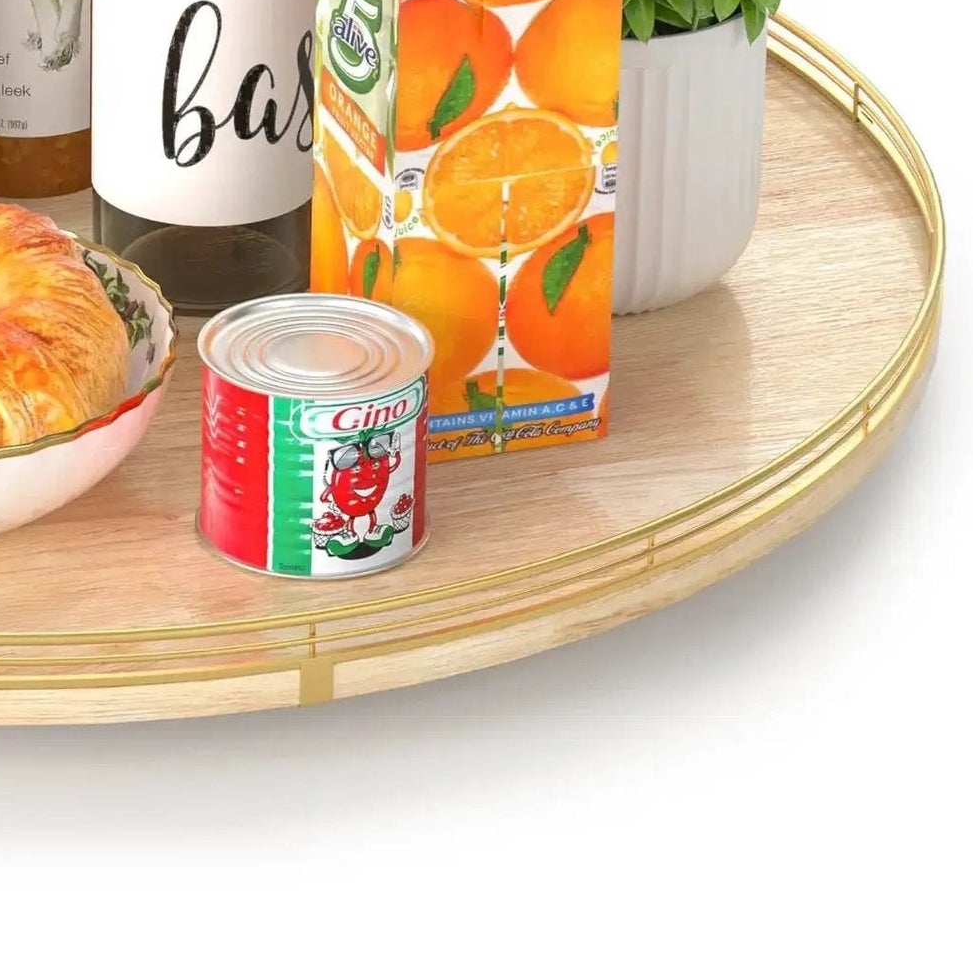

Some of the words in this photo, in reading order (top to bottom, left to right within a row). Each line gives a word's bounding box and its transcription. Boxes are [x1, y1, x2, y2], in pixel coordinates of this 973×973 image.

[333, 16, 377, 69] alive
[1, 84, 31, 97] leek
[329, 85, 378, 150] ORANGE
[332, 399, 408, 432] Gino
[479, 407, 538, 422] VIAMIN
[582, 397, 589, 408] E
[546, 420, 601, 436] Company
